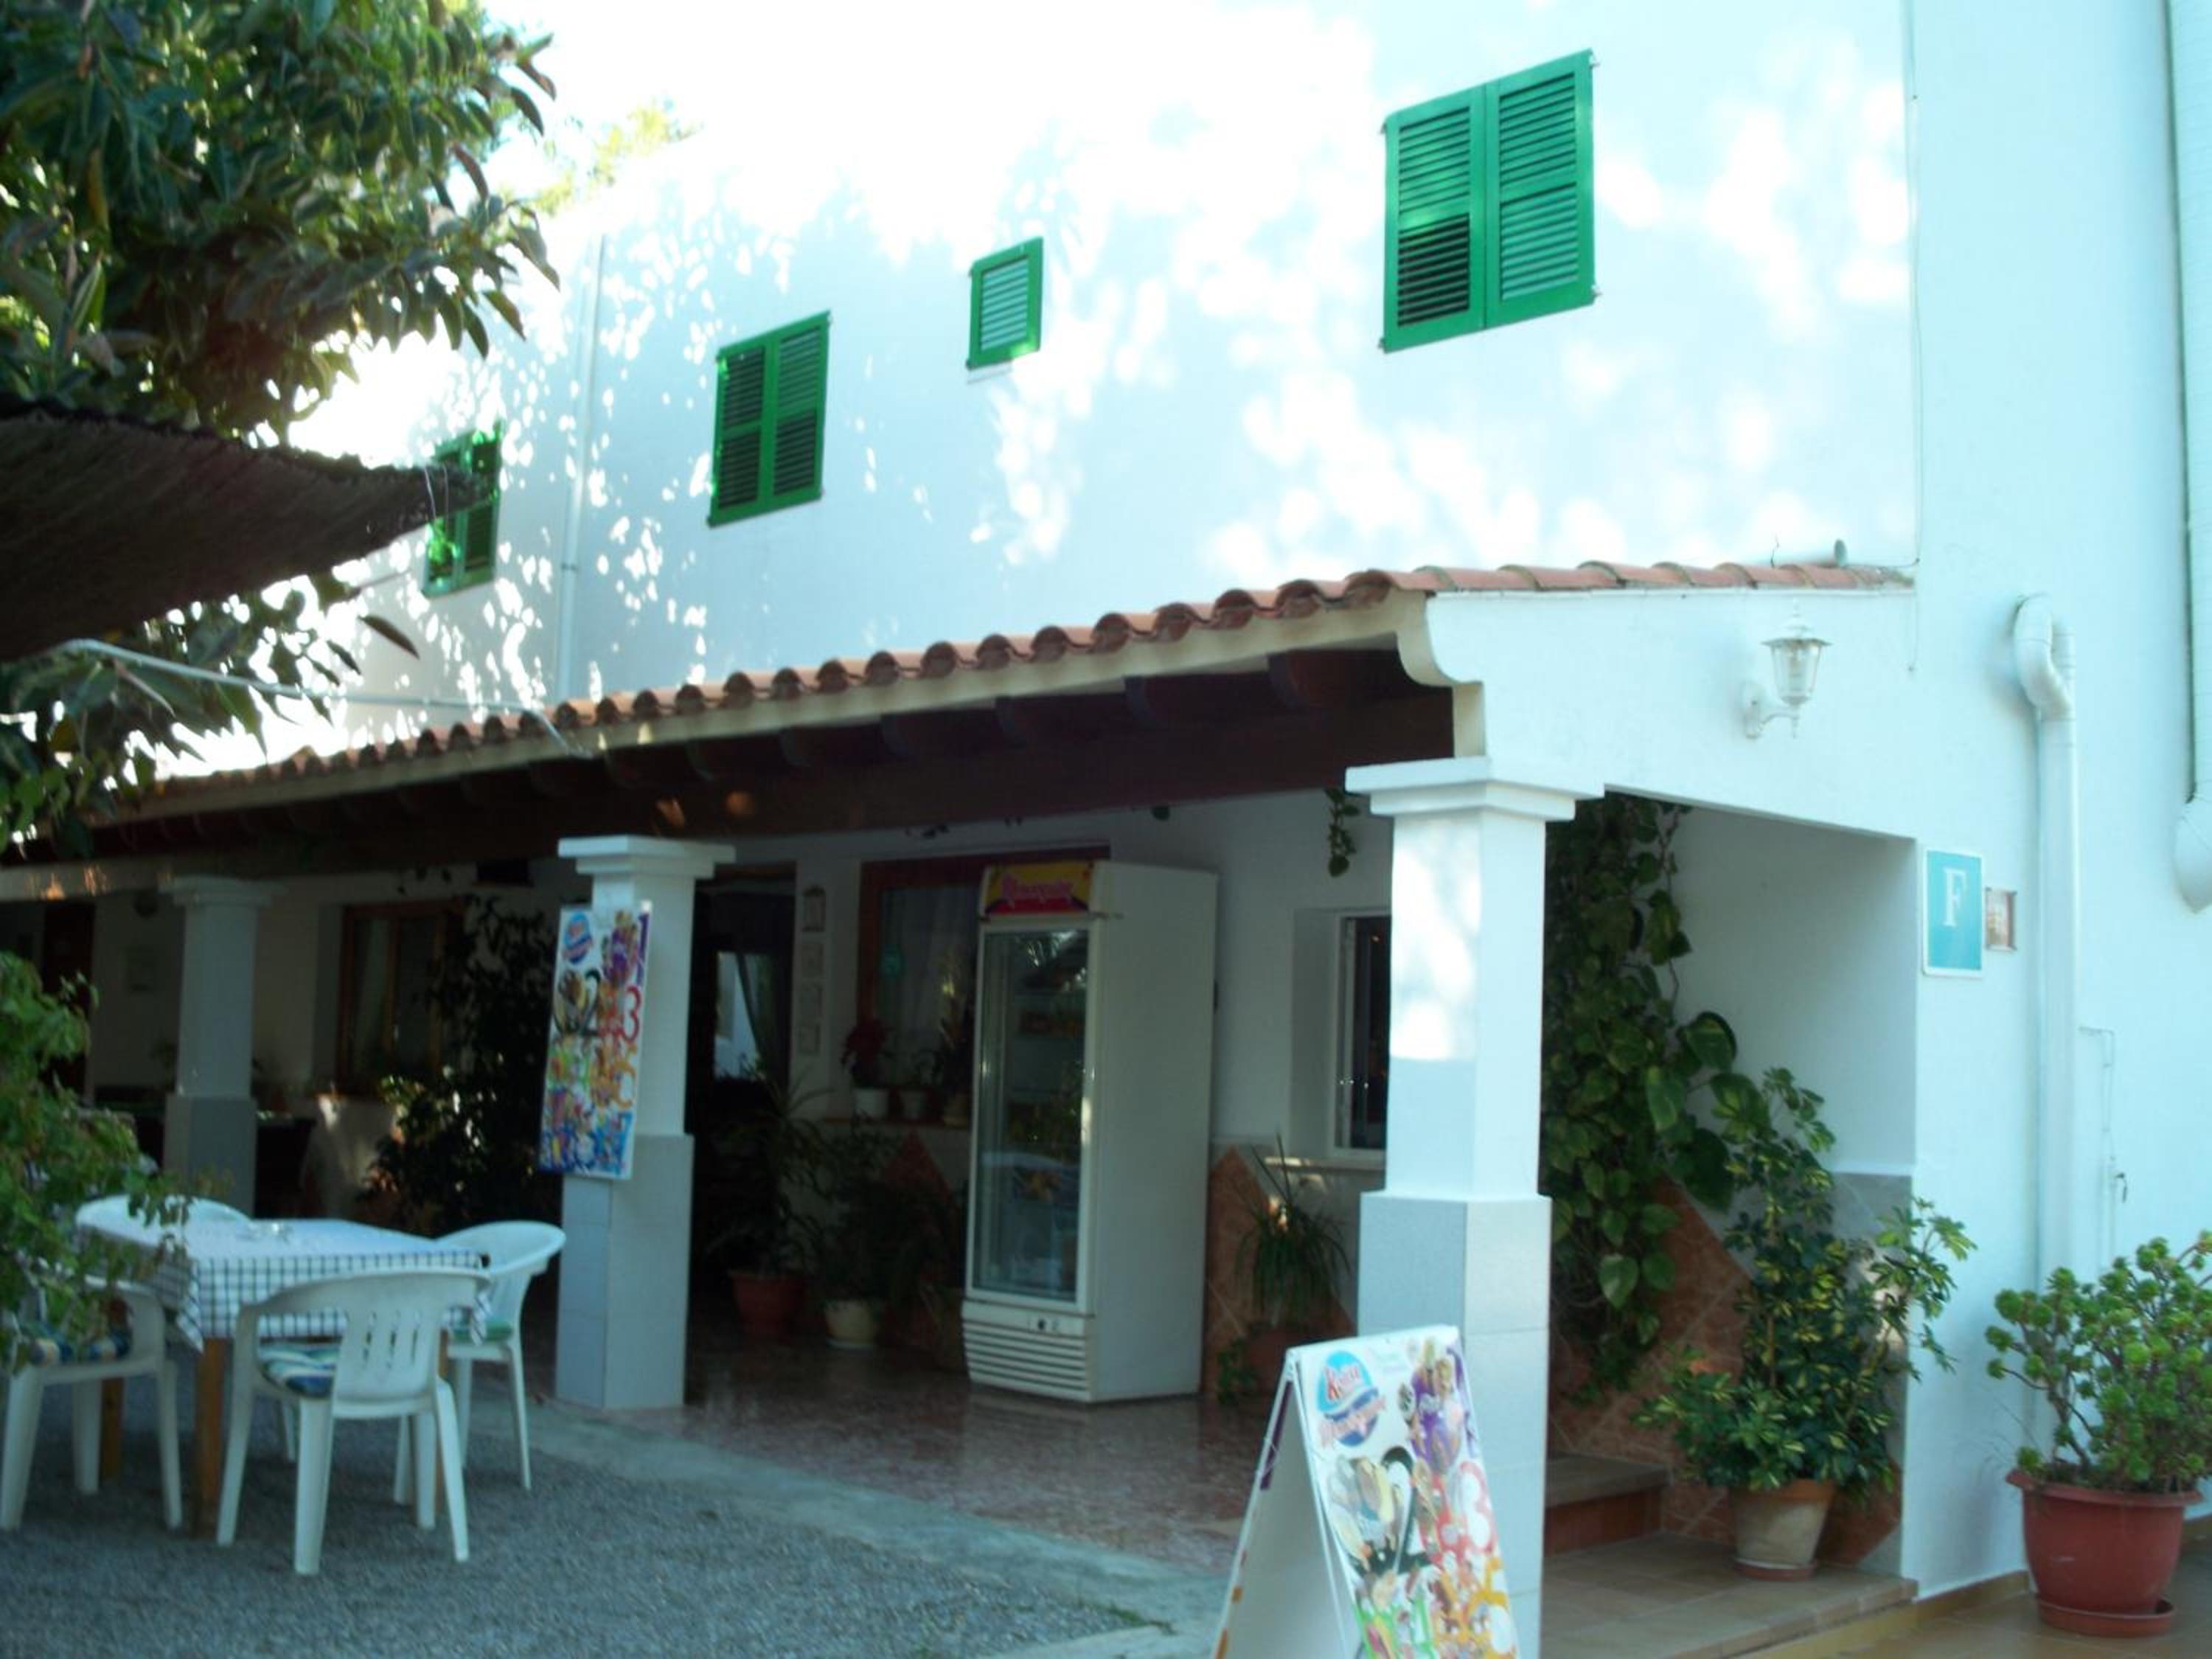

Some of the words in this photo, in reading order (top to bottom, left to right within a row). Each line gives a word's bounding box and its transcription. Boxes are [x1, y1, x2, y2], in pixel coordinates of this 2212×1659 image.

[1942, 866, 1967, 928] F
[618, 986, 642, 1044] 3
[1458, 1461, 1500, 1557] 3
